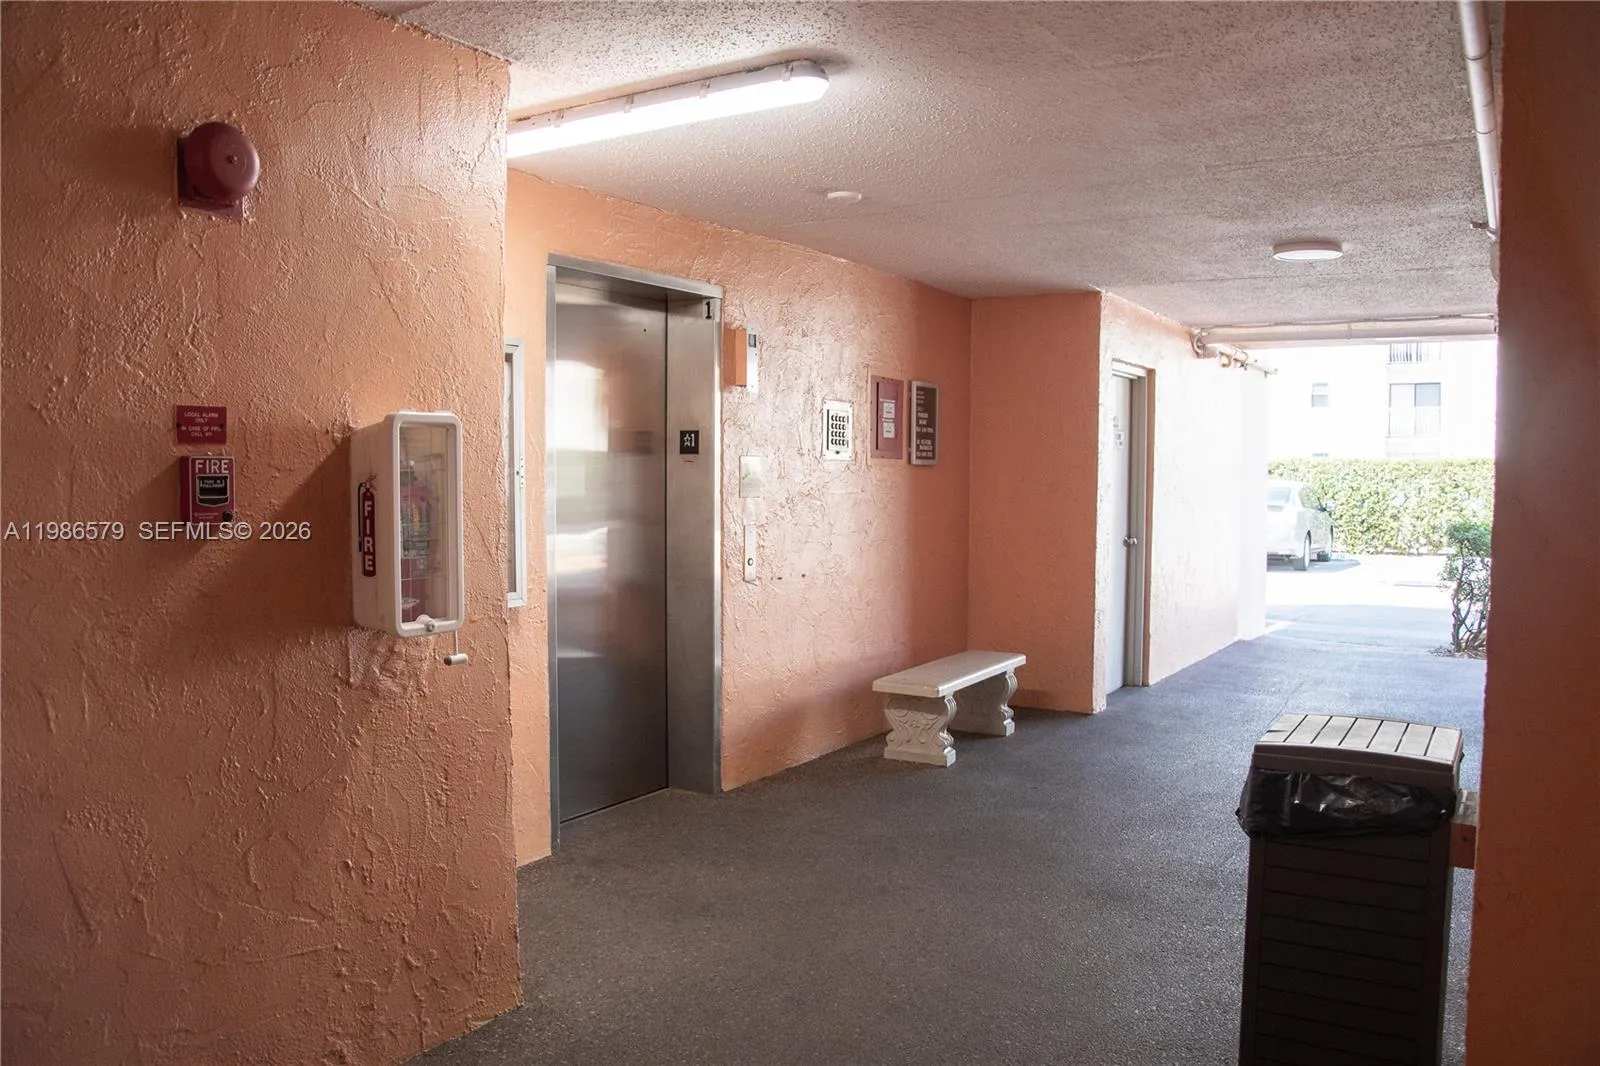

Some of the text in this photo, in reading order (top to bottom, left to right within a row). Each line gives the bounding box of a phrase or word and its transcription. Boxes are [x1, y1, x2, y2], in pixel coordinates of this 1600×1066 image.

[705, 301, 712, 319] 1
[195, 460, 229, 473] FIRE
[364, 501, 374, 571] FIRE
